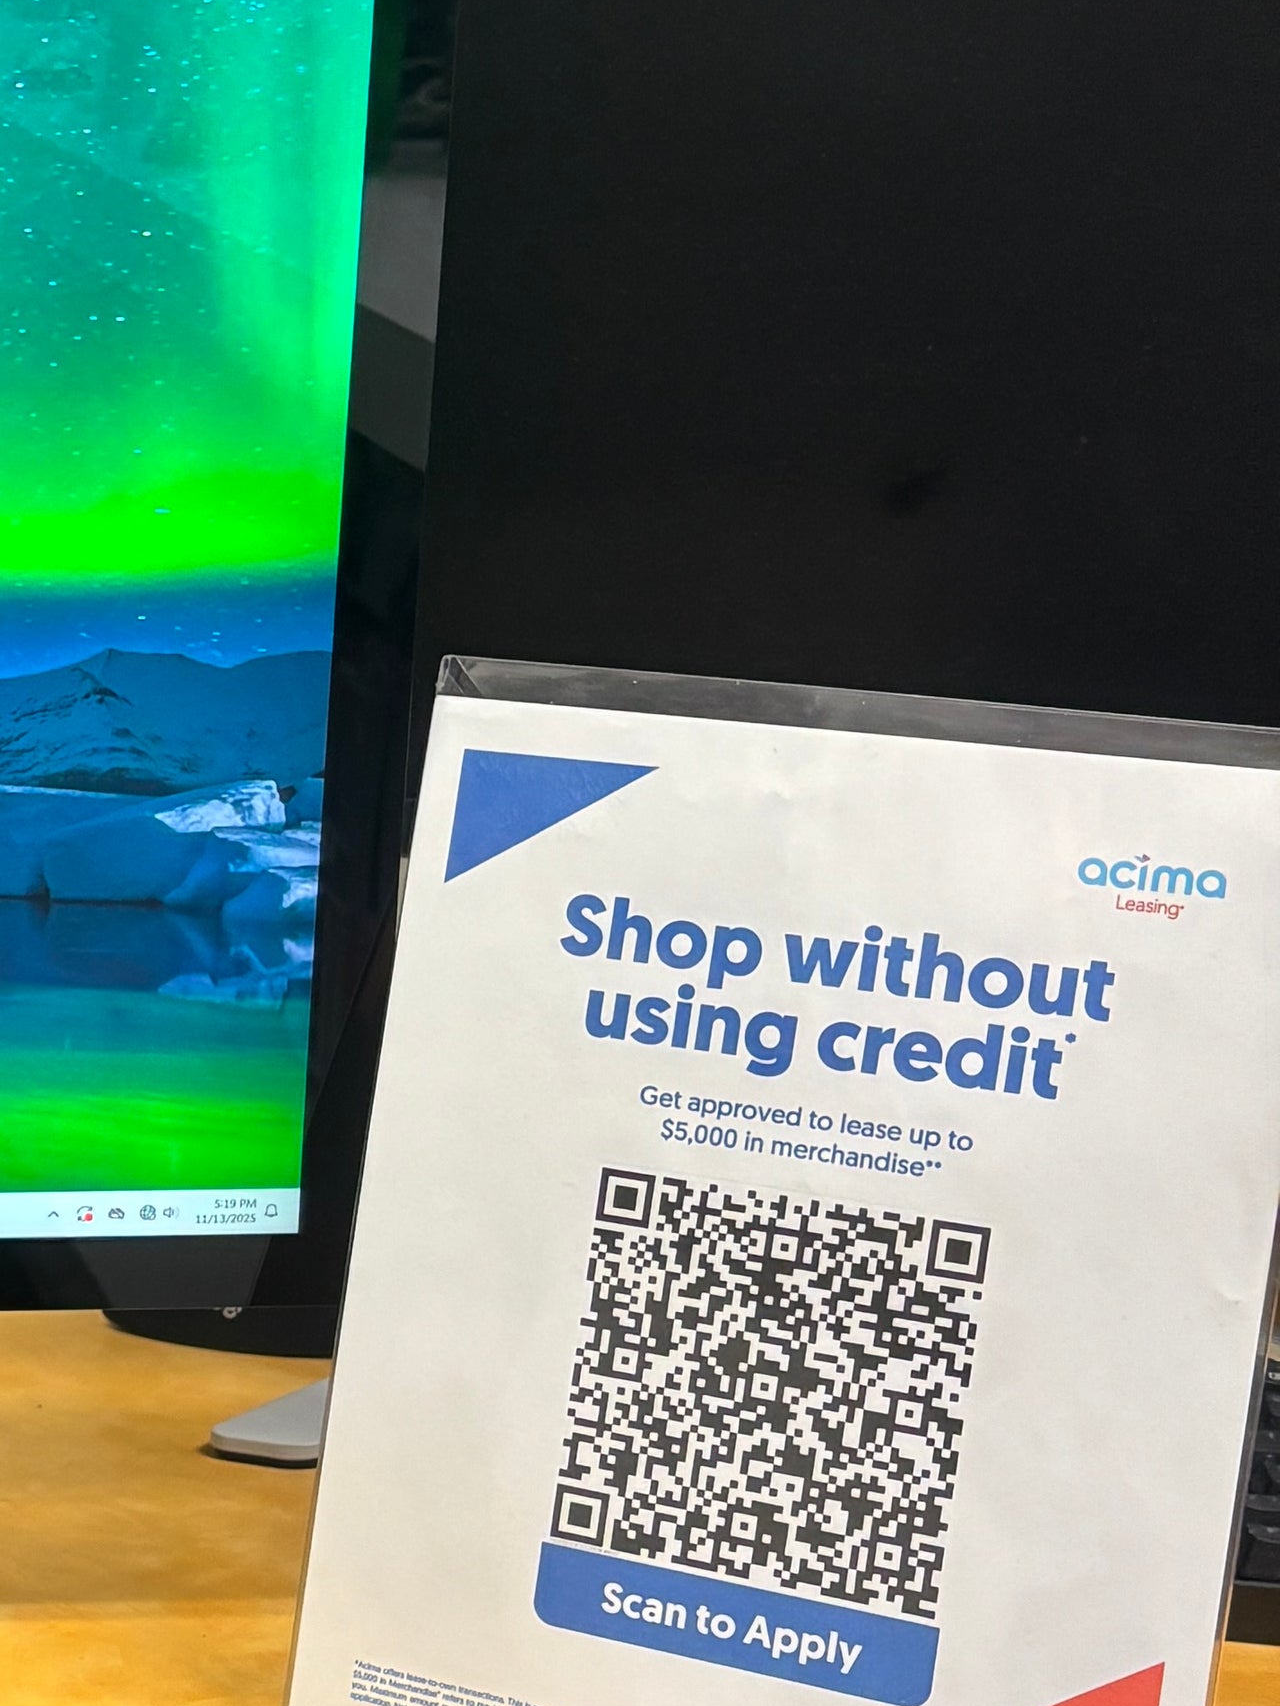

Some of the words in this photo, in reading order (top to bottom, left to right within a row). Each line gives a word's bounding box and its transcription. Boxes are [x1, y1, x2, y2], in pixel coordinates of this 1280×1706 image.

[1077, 853, 1227, 899] acima
[559, 893, 763, 991] Shop
[784, 924, 1116, 1023] without
[584, 985, 800, 1078] using
[639, 1085, 683, 1110] Get
[686, 1094, 802, 1127] approved
[808, 1110, 834, 1132] to
[839, 1113, 903, 1142] lease
[909, 1126, 941, 1152] up
[947, 1129, 974, 1152] to
[660, 1117, 738, 1149] $5,000
[744, 1130, 764, 1153] in
[196, 1213, 256, 1224] 11/13/2025
[214, 1199, 236, 1209] 5:19
[239, 1198, 258, 1209] PM
[600, 1580, 687, 1629] Scan
[696, 1605, 737, 1640] to
[742, 1614, 864, 1675] Apply
